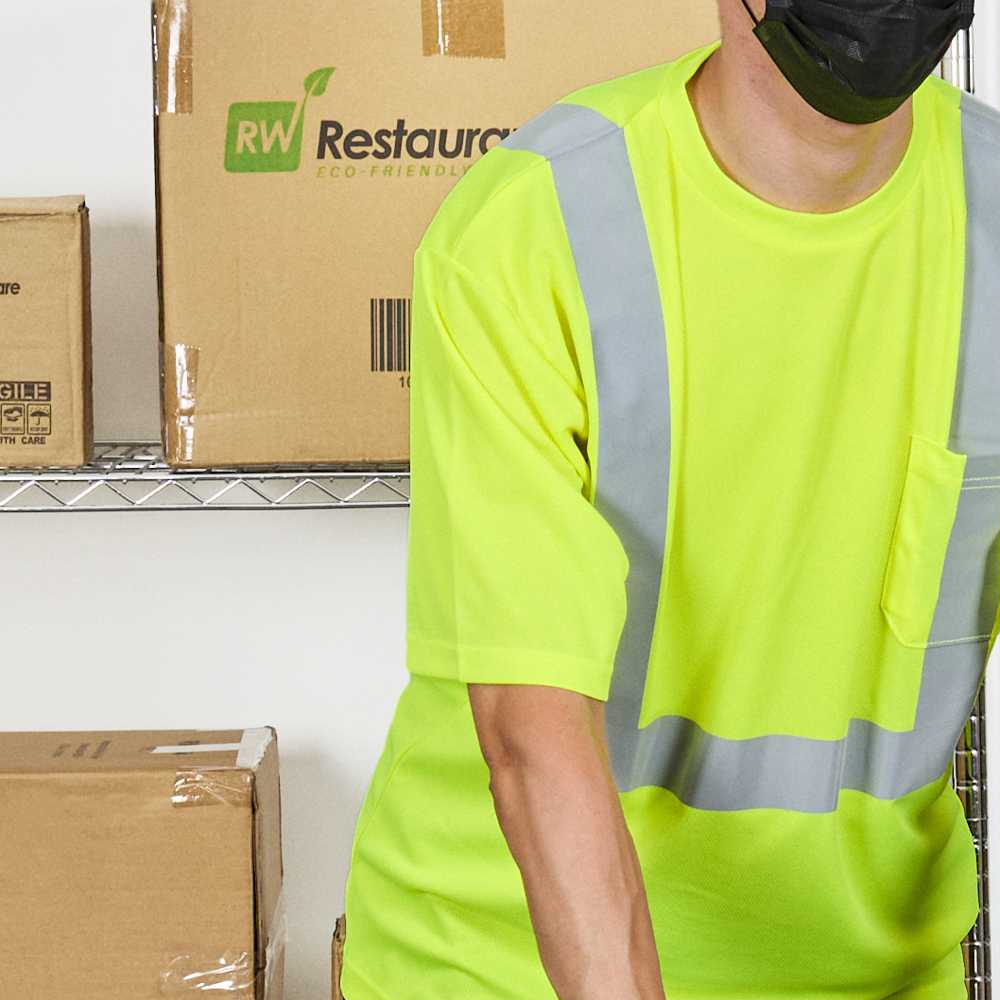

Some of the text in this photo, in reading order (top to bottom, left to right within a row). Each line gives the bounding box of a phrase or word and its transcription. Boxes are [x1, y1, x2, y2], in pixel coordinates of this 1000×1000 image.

[235, 120, 293, 154] RW
[316, 118, 517, 160] Restaura
[21, 436, 46, 445] CARE
